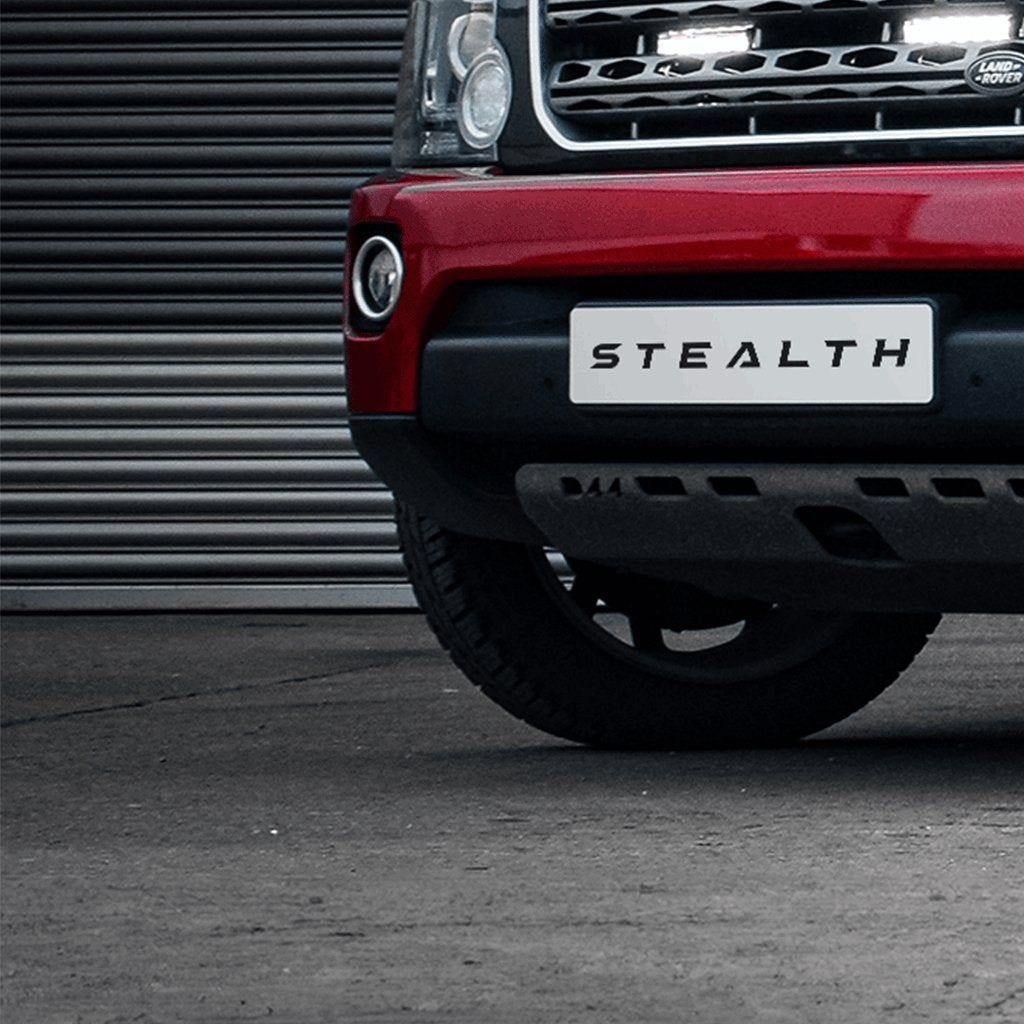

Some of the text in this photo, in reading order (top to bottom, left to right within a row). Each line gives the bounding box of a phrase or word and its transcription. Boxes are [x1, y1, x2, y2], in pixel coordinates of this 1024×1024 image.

[979, 60, 1013, 73] LAND
[981, 72, 1023, 84] ROVER
[590, 339, 910, 369] STEALTH
